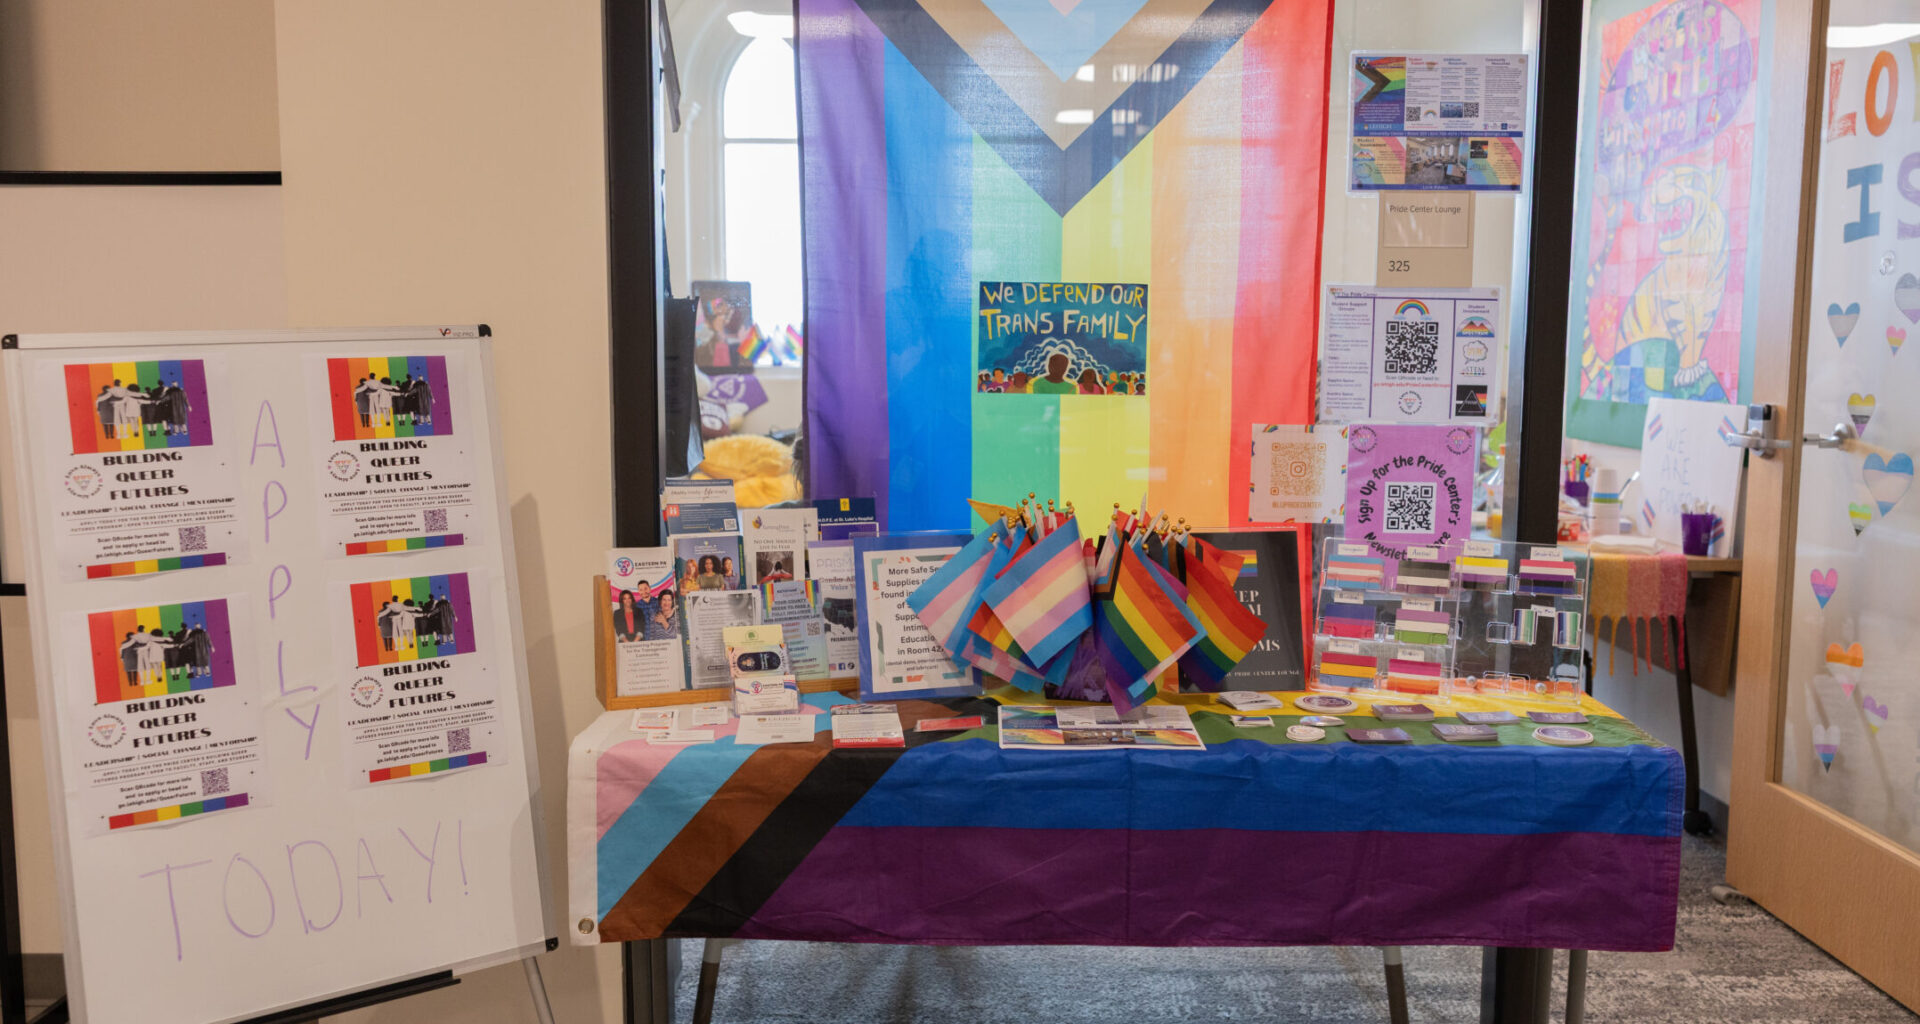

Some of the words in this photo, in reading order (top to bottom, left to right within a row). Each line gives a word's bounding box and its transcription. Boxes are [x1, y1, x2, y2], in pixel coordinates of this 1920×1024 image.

[1389, 205, 1408, 213] Pride
[1409, 205, 1433, 213] Center
[1434, 205, 1461, 215] Lounge
[1388, 260, 1410, 272] 325
[360, 440, 427, 452] BUILDING
[103, 451, 183, 466] BUILDING
[370, 456, 420, 468] QUEER
[1392, 455, 1414, 469] the
[1371, 462, 1390, 480] for
[1416, 455, 1447, 479] Pride
[115, 468, 174, 483] QUEER
[366, 470, 433, 484] FUTURES
[110, 485, 189, 500] FUTURES
[1360, 479, 1378, 497] Up
[1443, 477, 1463, 526] Center's
[1358, 499, 1374, 524] Sign
[910, 566, 928, 574] Safe
[886, 579, 920, 588] Supplies
[881, 591, 905, 599] found
[896, 602, 905, 610] of
[897, 647, 903, 655] in
[907, 646, 930, 655] Room
[383, 659, 451, 677] BUILDING
[393, 676, 444, 691] QUEER
[126, 693, 205, 714] BUILDING
[389, 690, 456, 709] FUTURES
[138, 712, 197, 729] QUEER
[132, 727, 212, 748] FUTURES
[139, 819, 470, 961] TODAY!
